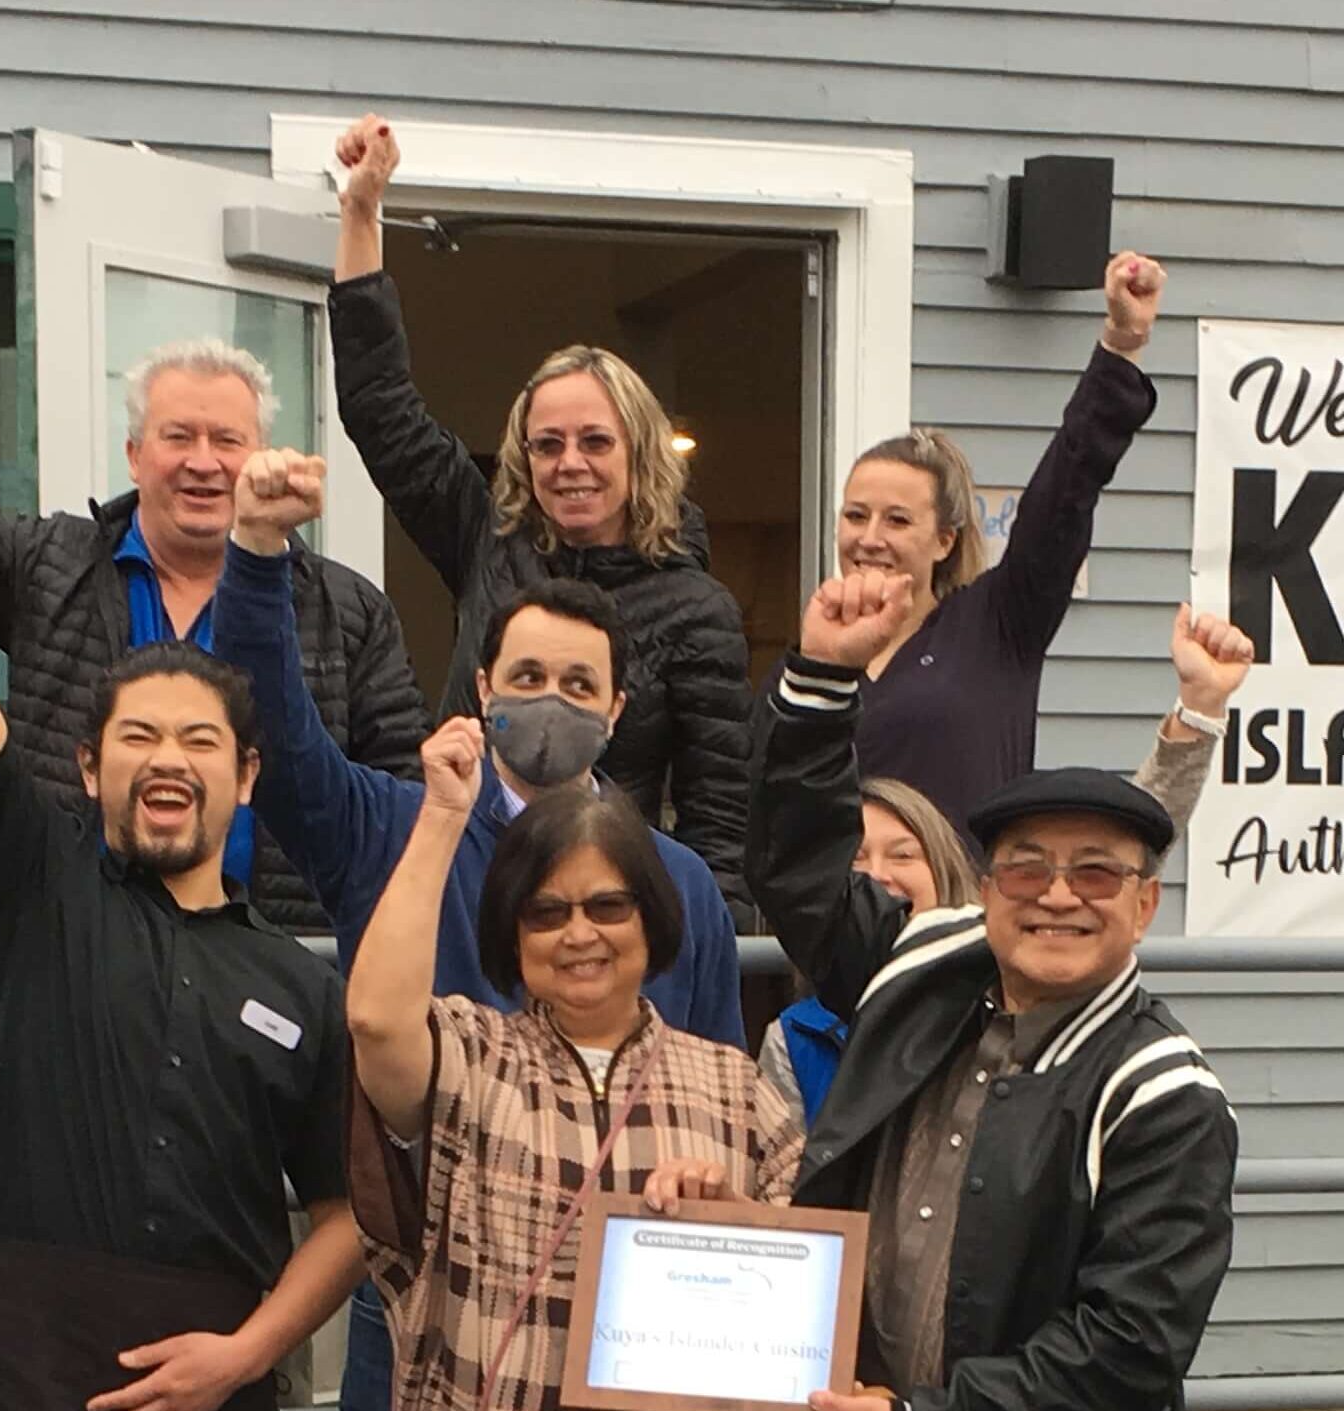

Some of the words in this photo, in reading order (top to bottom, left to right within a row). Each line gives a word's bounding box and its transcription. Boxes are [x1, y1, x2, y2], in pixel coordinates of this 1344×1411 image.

[637, 1232, 708, 1250] Certificate
[711, 1237, 724, 1249] of
[726, 1240, 809, 1257] Recognition
